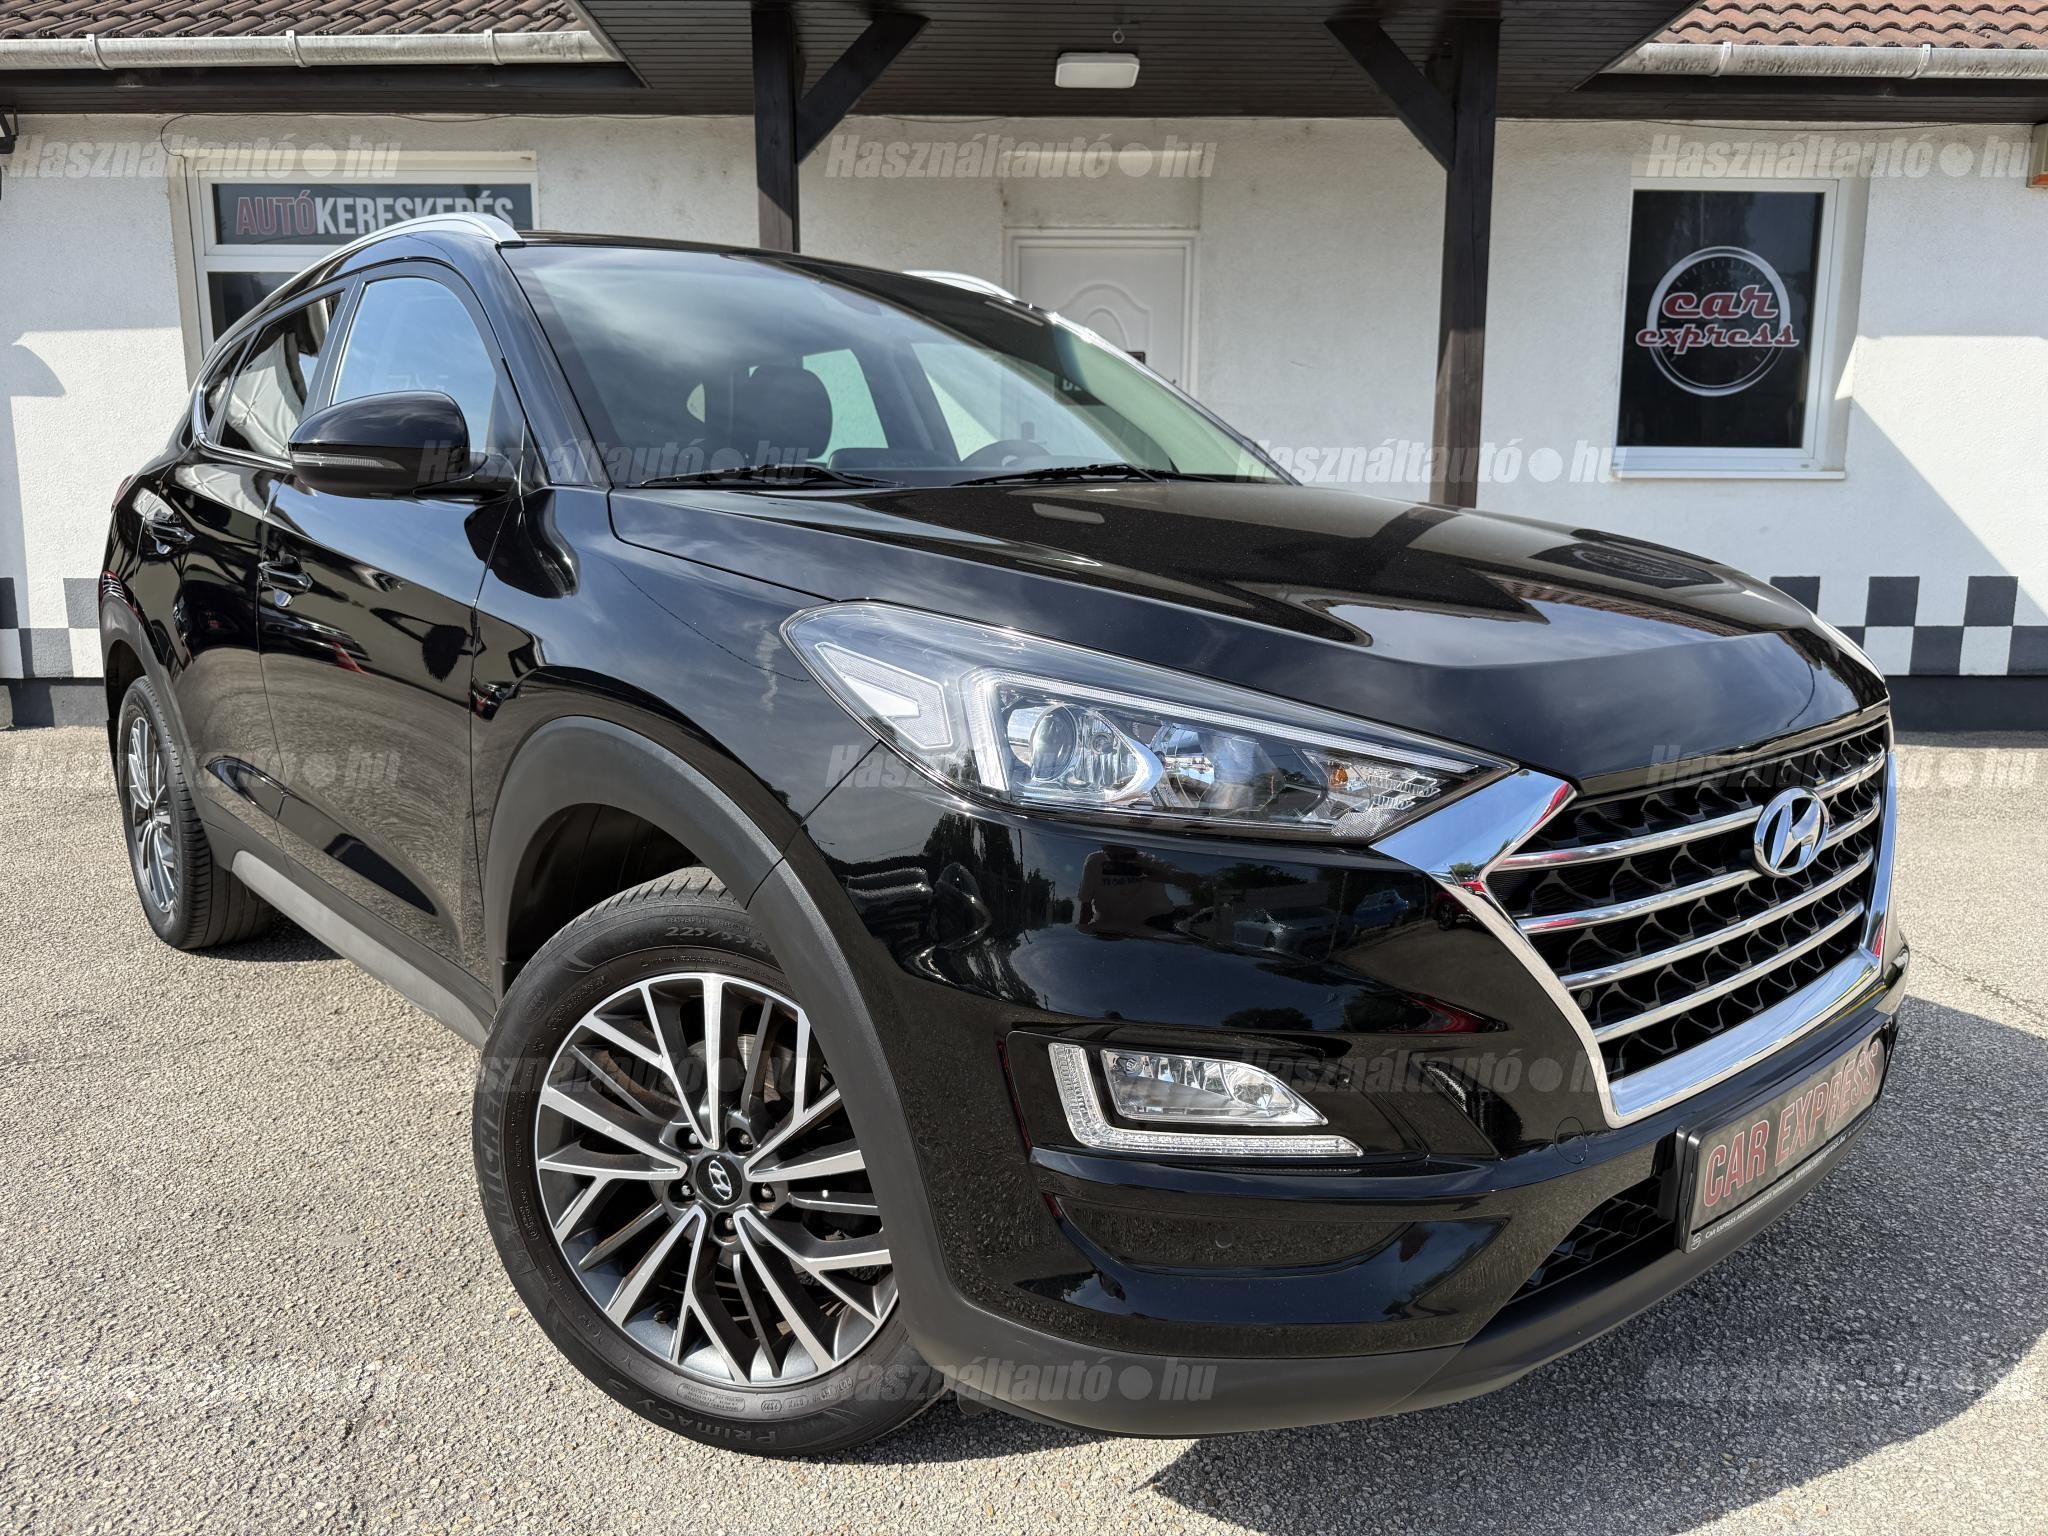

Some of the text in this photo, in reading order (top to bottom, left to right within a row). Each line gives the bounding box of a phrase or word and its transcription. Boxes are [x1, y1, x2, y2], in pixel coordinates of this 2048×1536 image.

[1662, 284, 1778, 319] car
[1636, 323, 1799, 355] express
[1703, 1041, 1879, 1208] CAR EXPRESS
